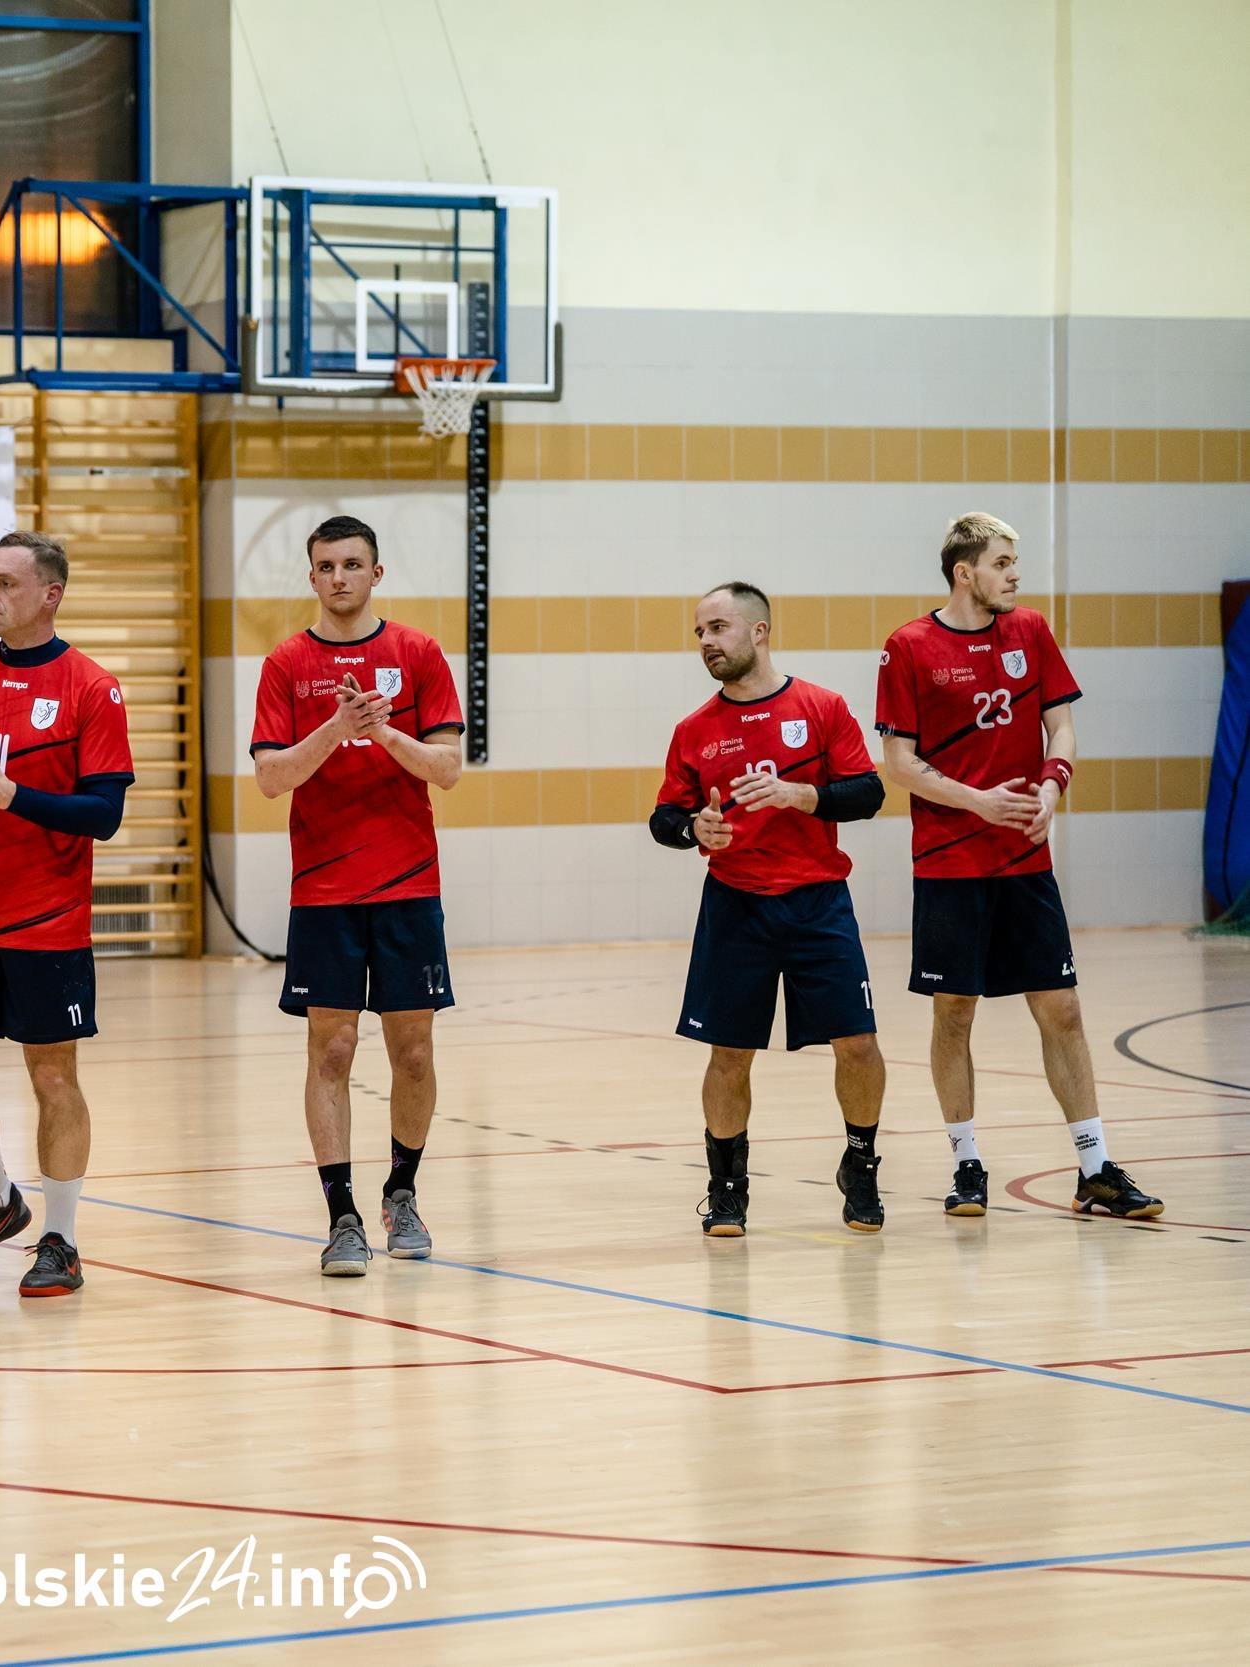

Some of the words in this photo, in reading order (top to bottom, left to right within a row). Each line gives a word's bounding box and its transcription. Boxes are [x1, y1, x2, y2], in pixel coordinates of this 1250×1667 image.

[968, 644, 992, 653] Kemp
[334, 656, 365, 666] Kempa
[2, 679, 29, 690] Kempa
[312, 679, 336, 688] Gmina
[312, 687, 338, 696] Czersk
[973, 688, 1013, 730] 23
[741, 711, 771, 723] Kempa
[719, 737, 743, 747] Gmina
[720, 745, 745, 755] Czersk
[67, 1003, 83, 1027] 11
